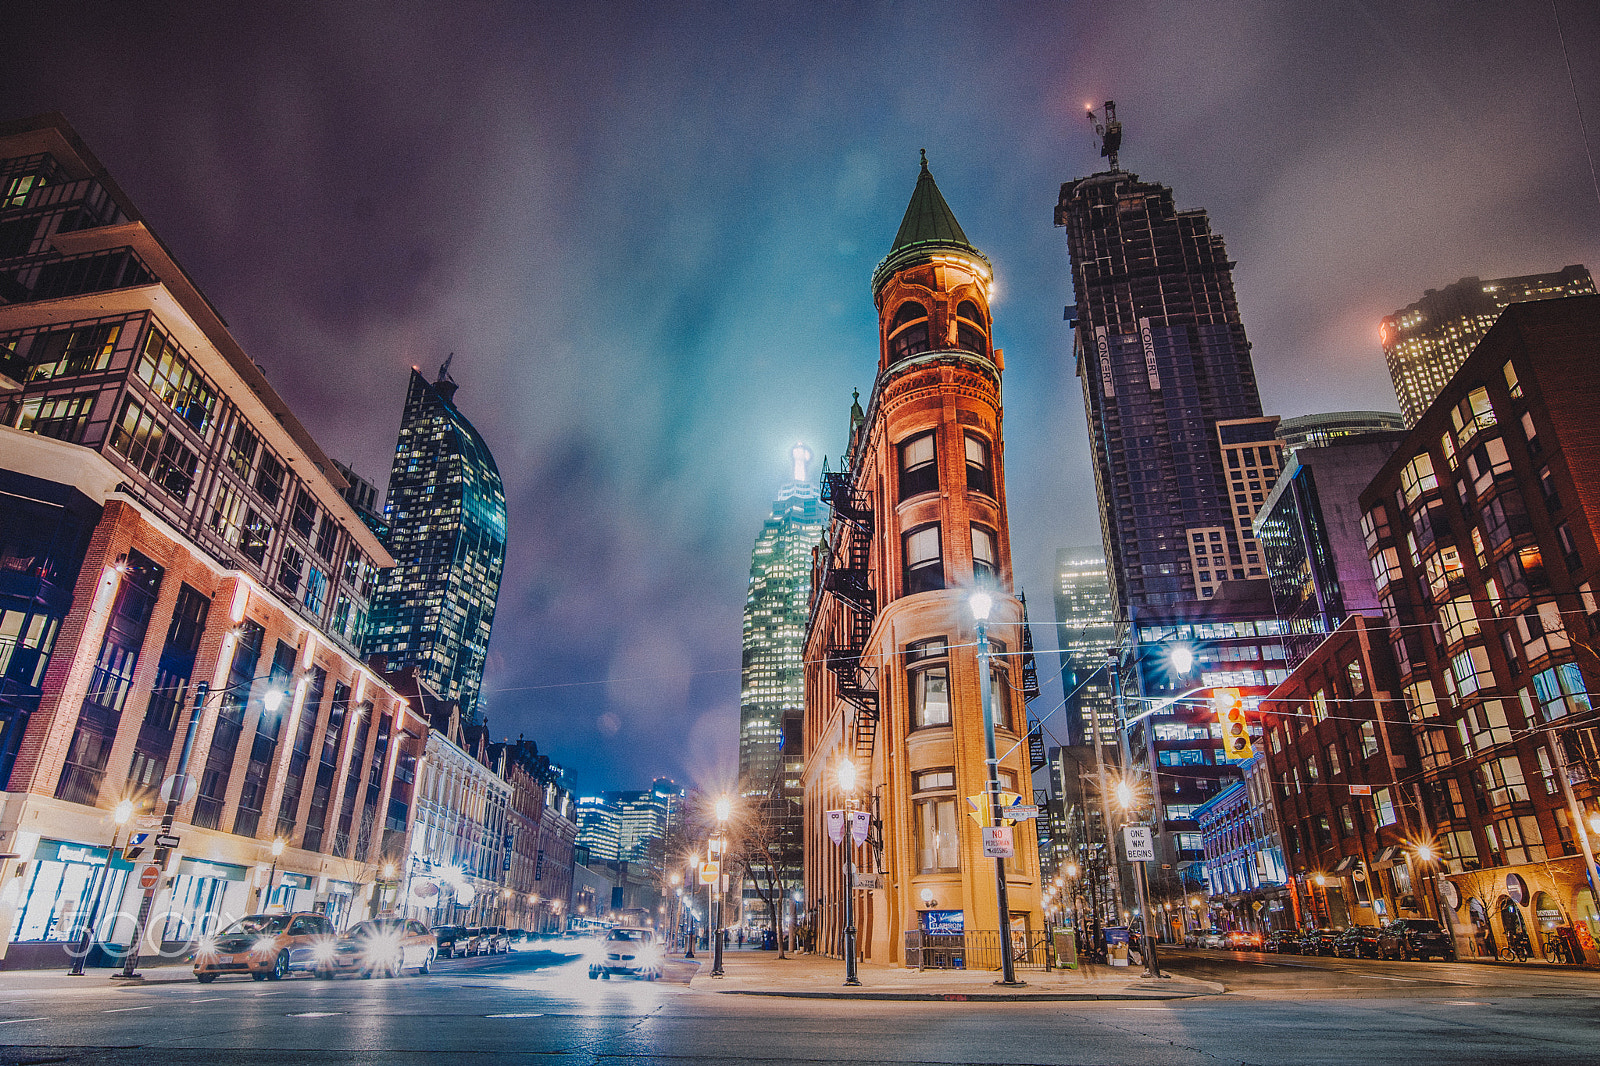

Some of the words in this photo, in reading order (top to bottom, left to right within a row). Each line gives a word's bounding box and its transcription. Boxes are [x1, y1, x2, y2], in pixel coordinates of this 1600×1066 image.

[1141, 327, 1158, 377] CONCERT
[1097, 334, 1112, 384] CONCERT
[992, 830, 1003, 838] NO
[1131, 840, 1145, 848] WAY
[1127, 850, 1152, 858] BEGINS
